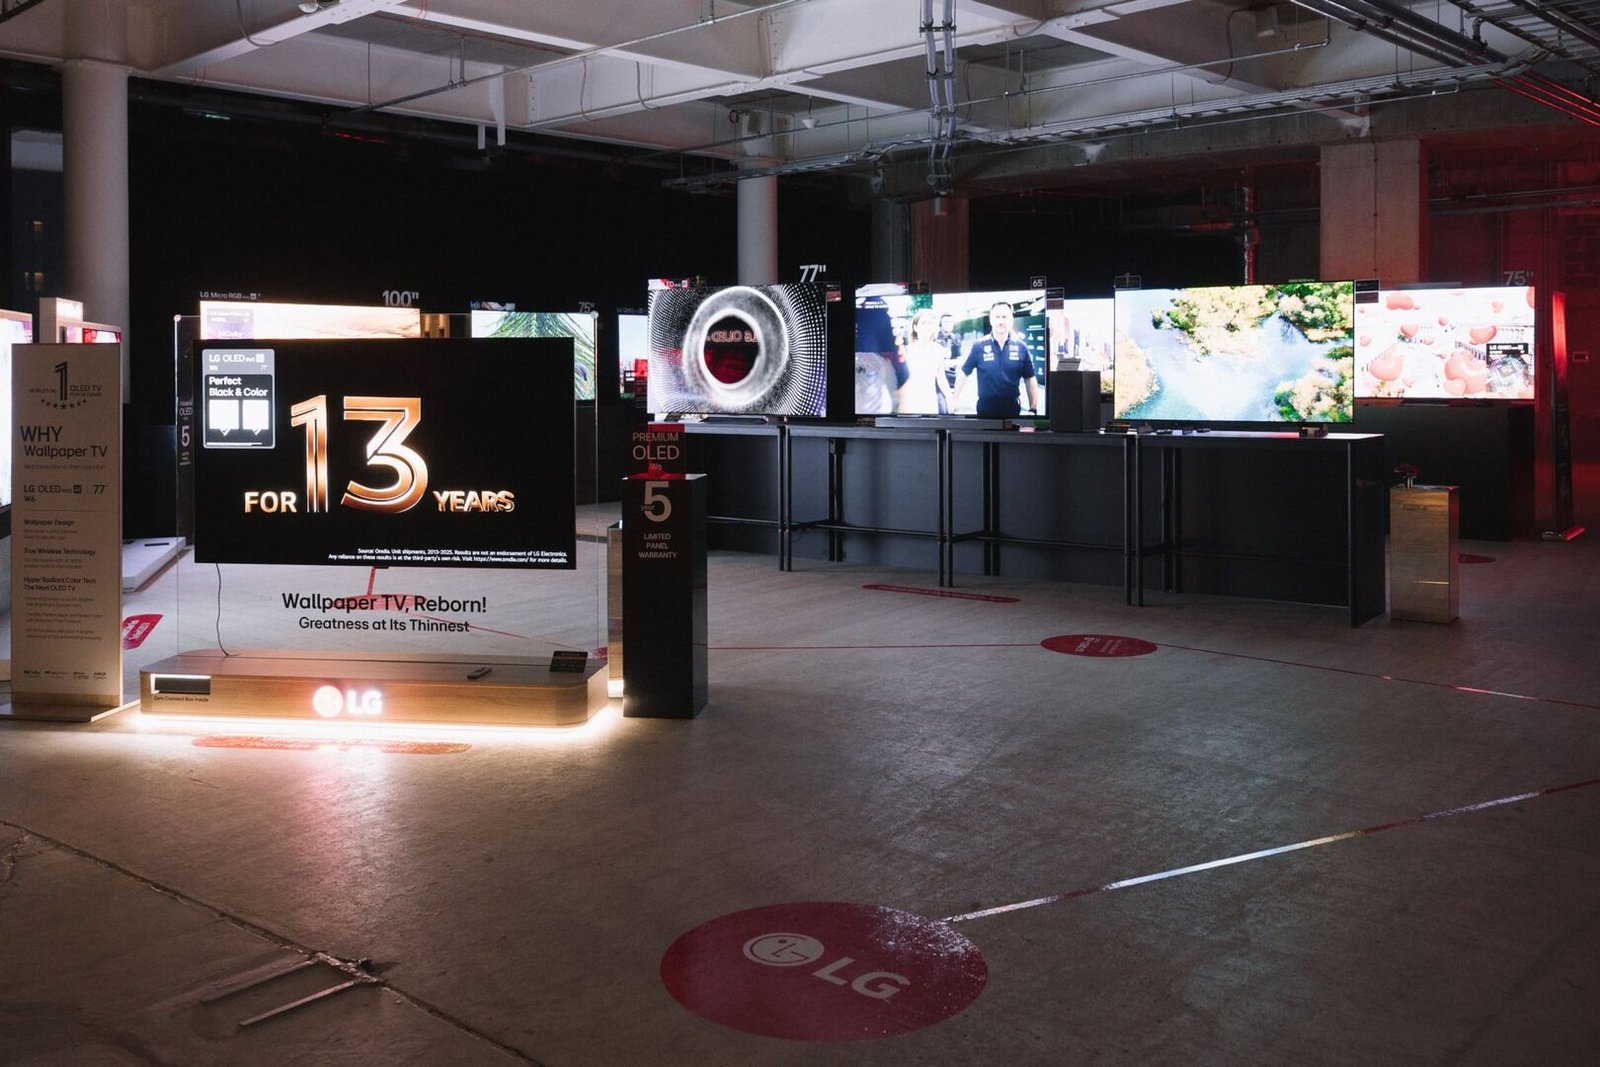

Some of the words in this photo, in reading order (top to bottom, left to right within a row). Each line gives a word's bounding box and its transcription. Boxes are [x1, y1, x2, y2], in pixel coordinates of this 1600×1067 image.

[800, 264, 826, 282] 77"
[382, 290, 419, 306] 100"
[209, 354, 220, 362] LG
[223, 354, 245, 362] OLED
[69, 384, 90, 392] OLED
[209, 376, 242, 385] Perfect
[209, 387, 234, 396] Black
[235, 388, 242, 396] &
[243, 388, 268, 396] Color
[20, 426, 62, 442] WHY
[181, 425, 190, 447] 5
[632, 432, 679, 442] PREMIUM
[24, 445, 88, 459] Wallpaper
[90, 445, 108, 457] TV
[244, 491, 297, 513] FOR
[290, 394, 429, 514] 13
[433, 490, 515, 513] YEARS
[632, 445, 680, 460] OLED
[24, 485, 35, 493] LG
[38, 485, 61, 493] OLED
[644, 481, 672, 522] 5
[282, 593, 377, 613] Wallpaper
[382, 594, 410, 613] TV,
[414, 596, 487, 613] Reborn!
[299, 617, 369, 630] Greatness
[373, 619, 386, 631] at
[390, 619, 407, 631] Its
[410, 619, 470, 632] Thinnest
[346, 690, 383, 716] LG
[811, 956, 911, 1000] LG
